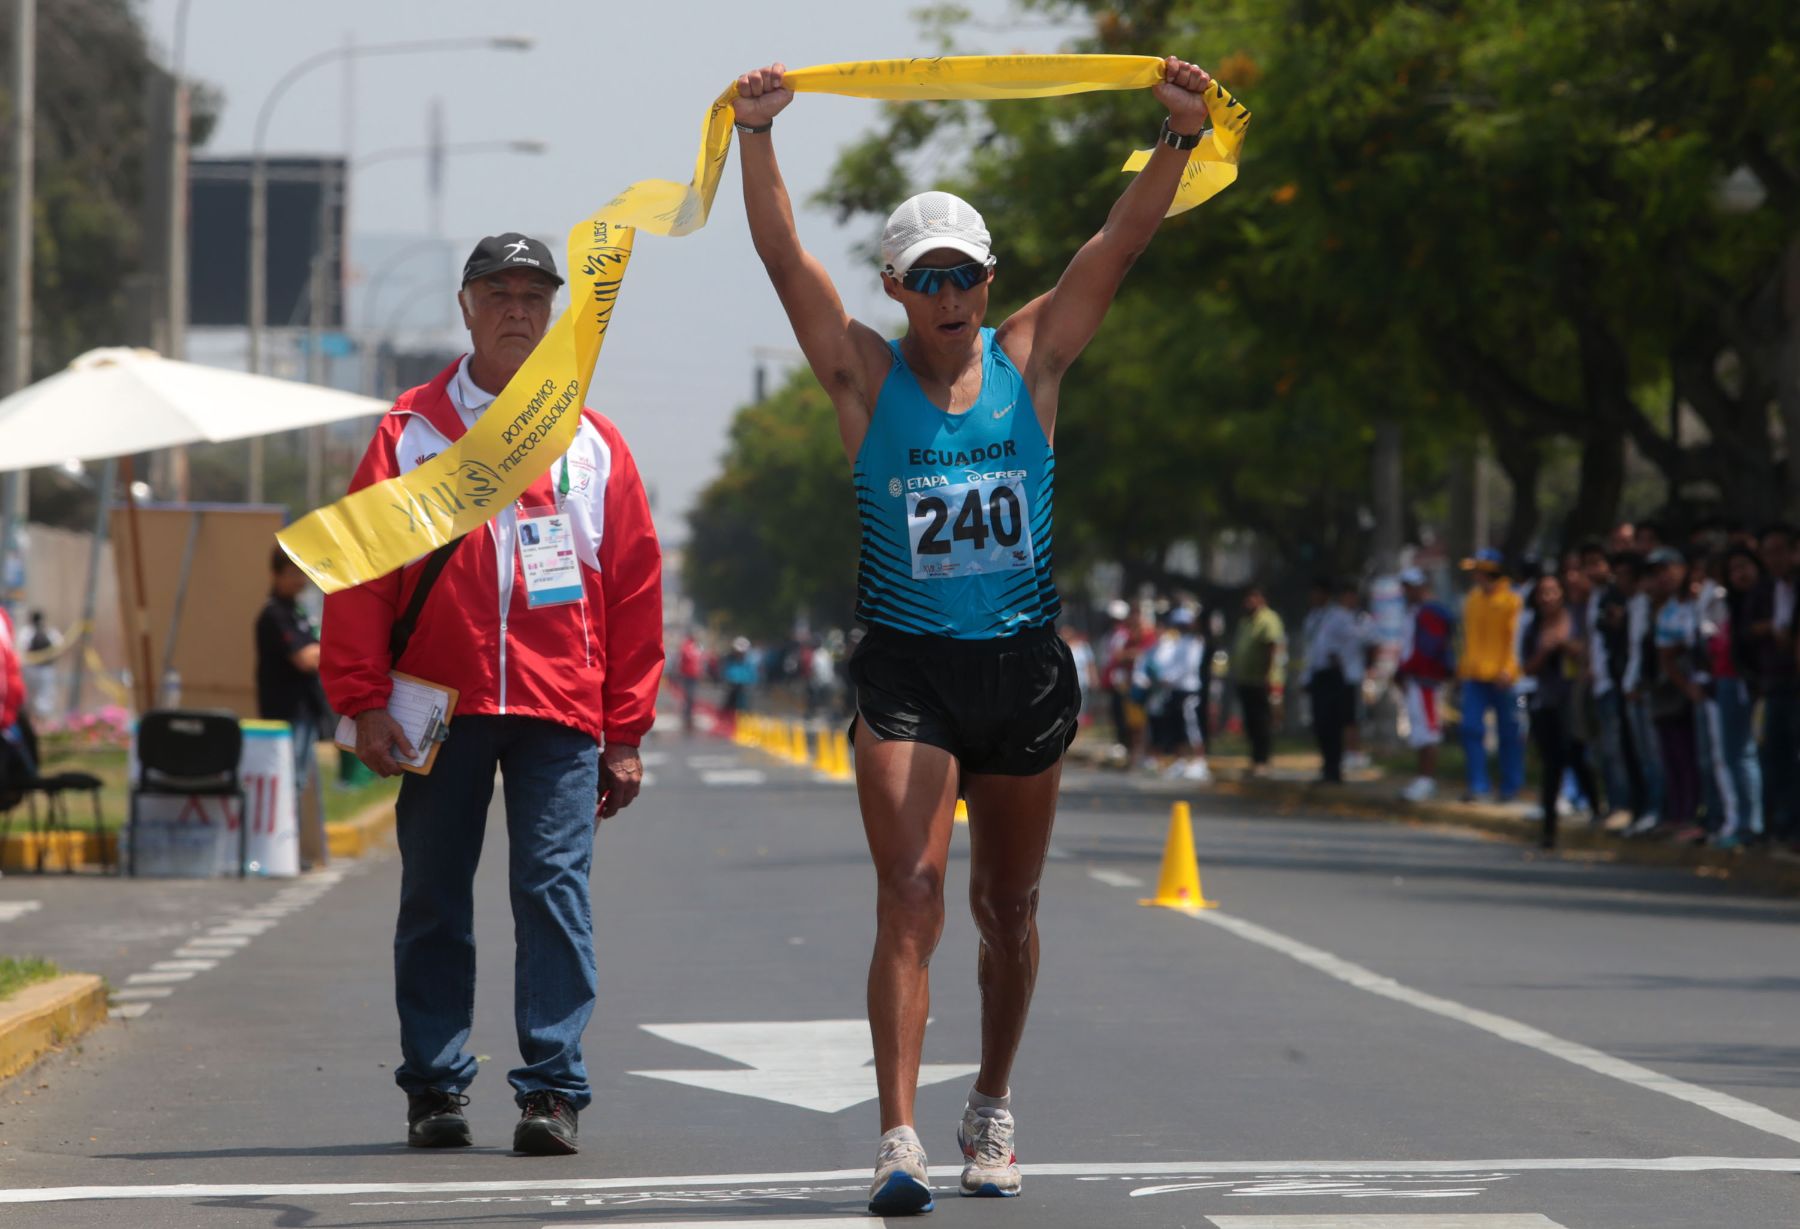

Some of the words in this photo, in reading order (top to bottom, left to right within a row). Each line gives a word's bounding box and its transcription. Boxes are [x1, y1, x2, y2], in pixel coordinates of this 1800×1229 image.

[908, 440, 1017, 467] ECUADOR
[907, 474, 950, 490] ETAPA
[914, 486, 1022, 555] 240
